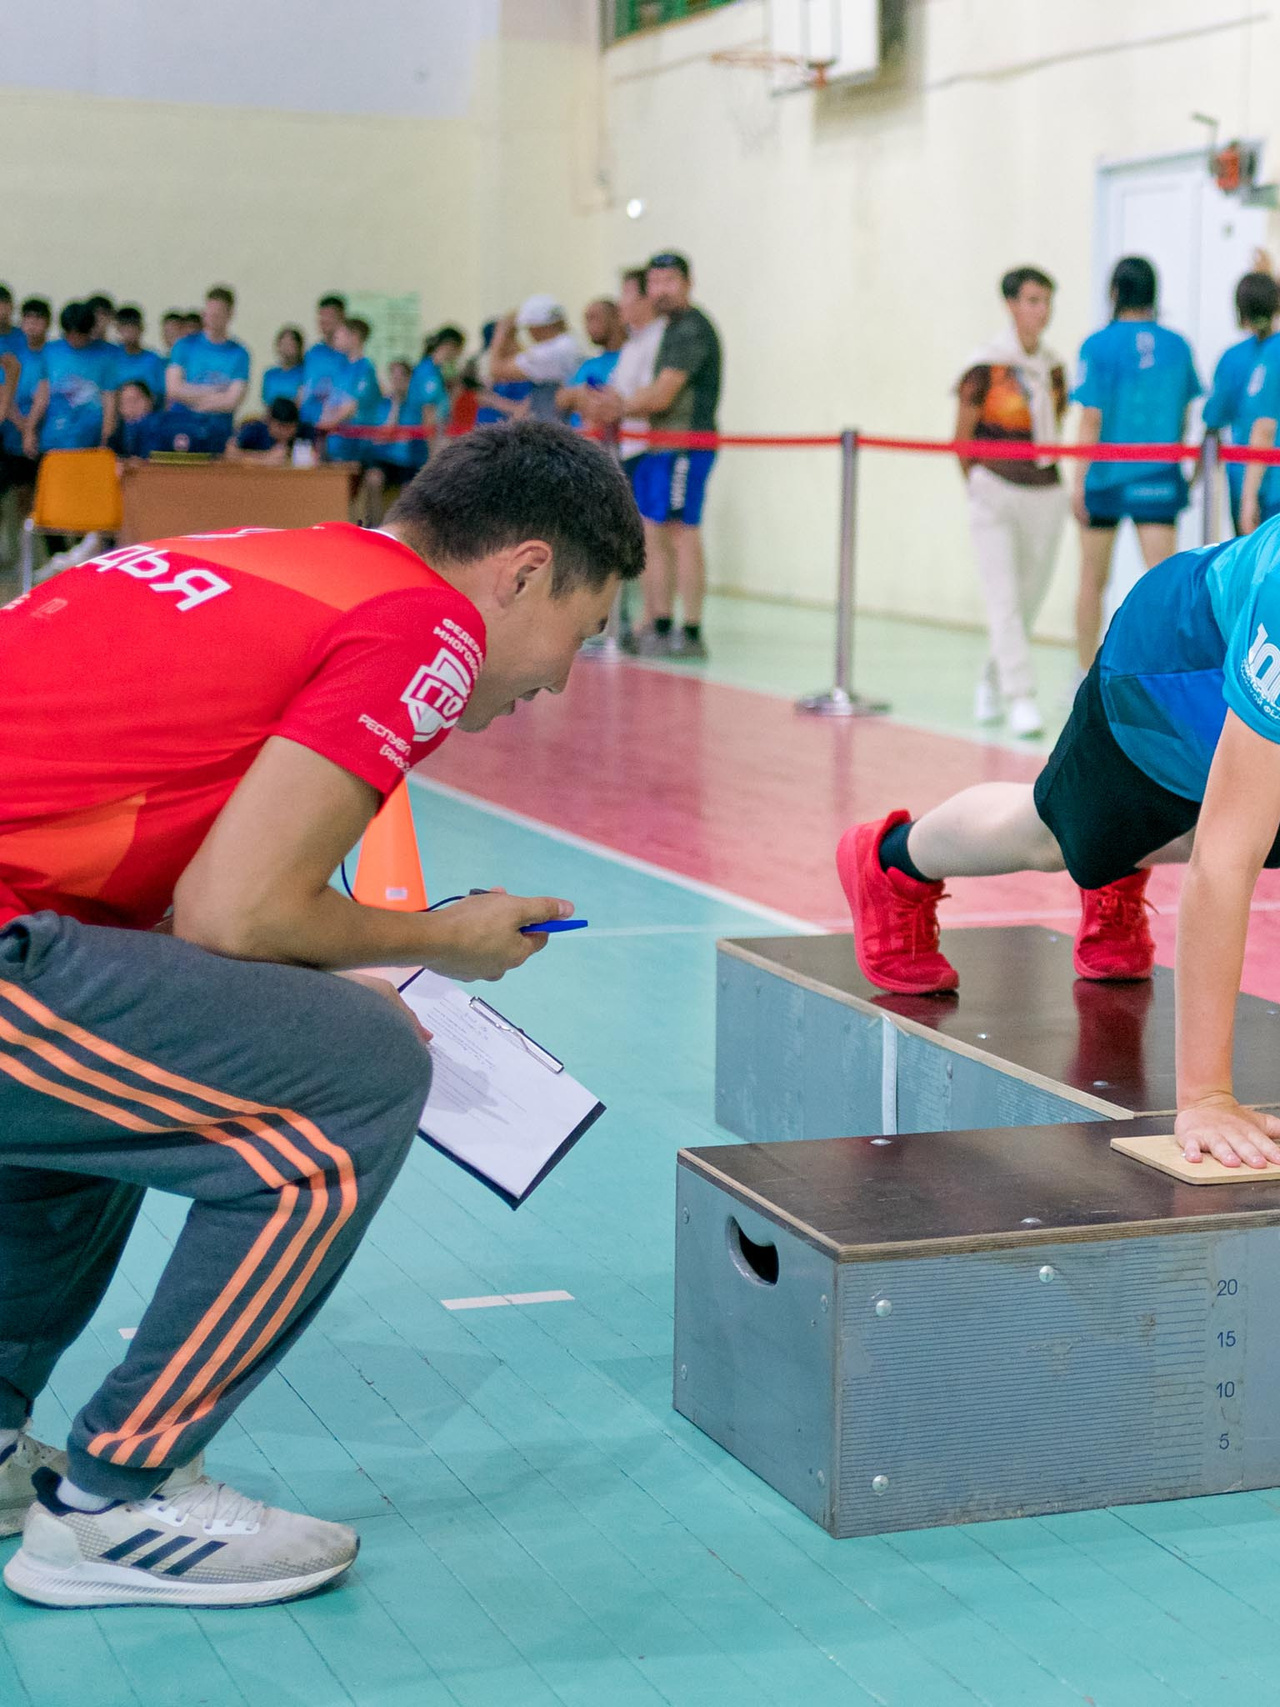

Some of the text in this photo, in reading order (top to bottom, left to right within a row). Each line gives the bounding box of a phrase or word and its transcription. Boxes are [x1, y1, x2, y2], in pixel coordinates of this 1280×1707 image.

[415, 676, 465, 718] ГТО
[358, 713, 412, 757] РЕСПУБЛ
[1216, 1278, 1238, 1297] 20
[1216, 1330, 1236, 1348] 15
[1216, 1381, 1235, 1398] 10
[1219, 1433, 1230, 1450] 5
